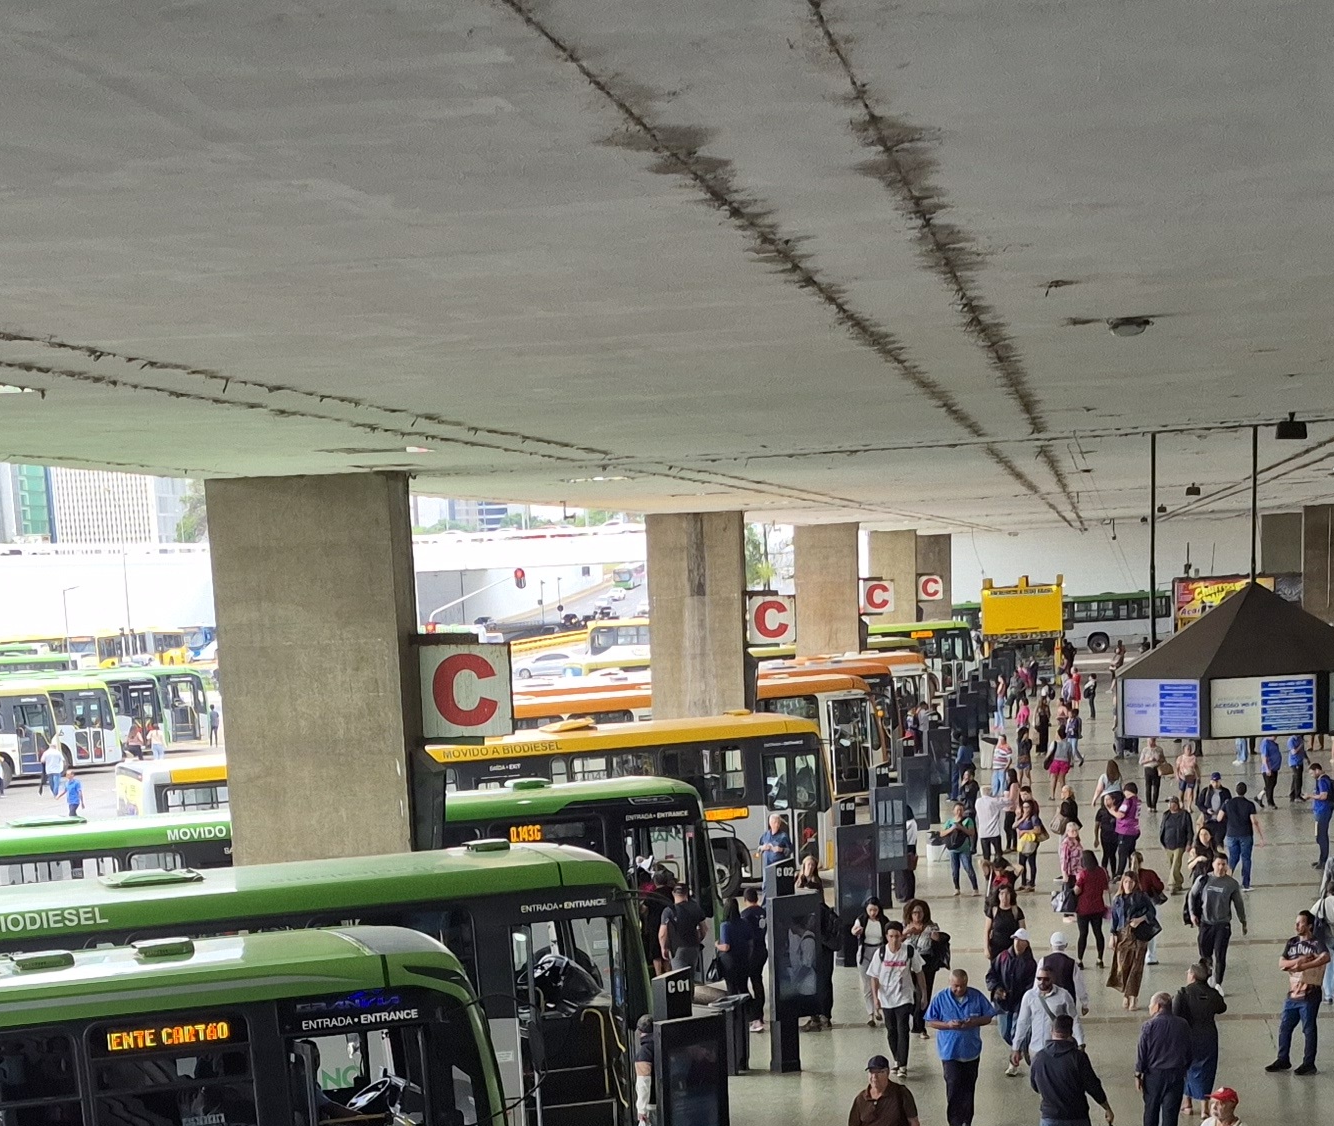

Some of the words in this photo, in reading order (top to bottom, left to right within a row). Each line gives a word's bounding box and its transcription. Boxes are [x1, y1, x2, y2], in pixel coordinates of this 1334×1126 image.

[866, 583, 890, 609] C
[921, 578, 940, 597] C
[754, 600, 789, 639] C
[432, 653, 498, 727] C
[443, 746, 489, 760] MOVIDO
[491, 746, 500, 756] A
[503, 742, 563, 755] BIODIESEL
[625, 814, 653, 822] ENTRADA
[657, 810, 689, 819] ENTRANCE
[167, 826, 227, 842] MOVIDO
[777, 867, 783, 877] C
[783, 866, 794, 876] 02
[521, 898, 559, 914] ENTRADA
[563, 898, 607, 910] ENTRANCE
[667, 980, 675, 994] C
[677, 979, 689, 992] 01
[301, 1016, 353, 1030] ENTRADA
[360, 1008, 419, 1024] ENTRANCE
[107, 1029, 157, 1051] ENTE
[161, 1022, 229, 1045] CARTÃO
